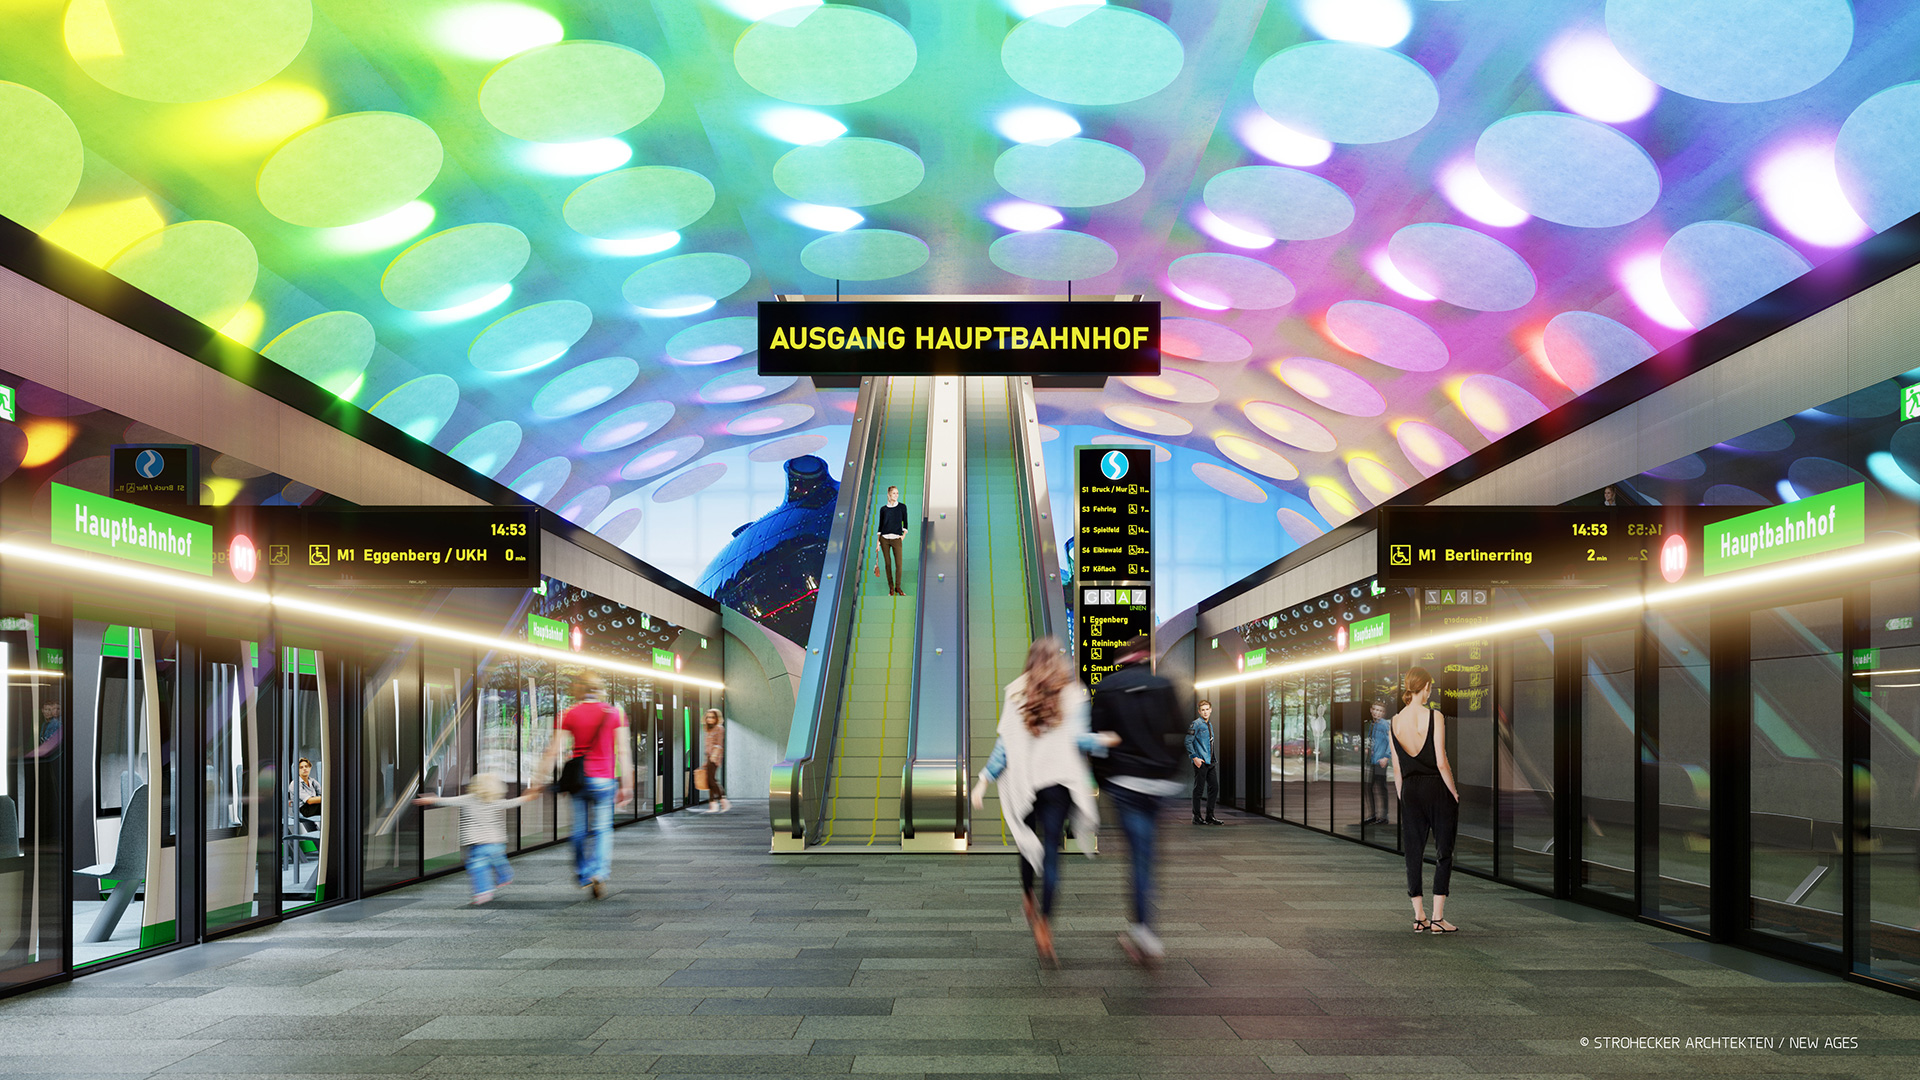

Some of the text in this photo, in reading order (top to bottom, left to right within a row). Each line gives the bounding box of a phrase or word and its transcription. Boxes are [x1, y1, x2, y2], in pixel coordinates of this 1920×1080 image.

[769, 327, 1149, 350] AUSGANG HAUPTBAHNHOF
[1093, 505, 1117, 514] Fehring
[75, 503, 192, 557] Hauptbahnhof
[491, 523, 527, 536] 14:53
[1093, 526, 1120, 534] Spielfeld
[1572, 523, 1608, 536] 14:53
[1720, 505, 1836, 558] Hauptbahnhof
[234, 544, 254, 572] M1
[337, 548, 355, 561] M1
[363, 548, 441, 564] Eggenberg
[444, 547, 453, 563] /
[456, 548, 487, 561] UKH
[505, 548, 514, 561] 0
[1418, 548, 1436, 561] M1
[1445, 548, 1533, 564] Berlinerring
[1587, 548, 1595, 561] 2
[1665, 544, 1684, 572] M1
[1085, 590, 1145, 604] GRAZ
[1089, 616, 1129, 625] Eggenberg
[1082, 639, 1088, 647] 4
[1082, 664, 1088, 672] 6
[1091, 664, 1114, 672] Smart
